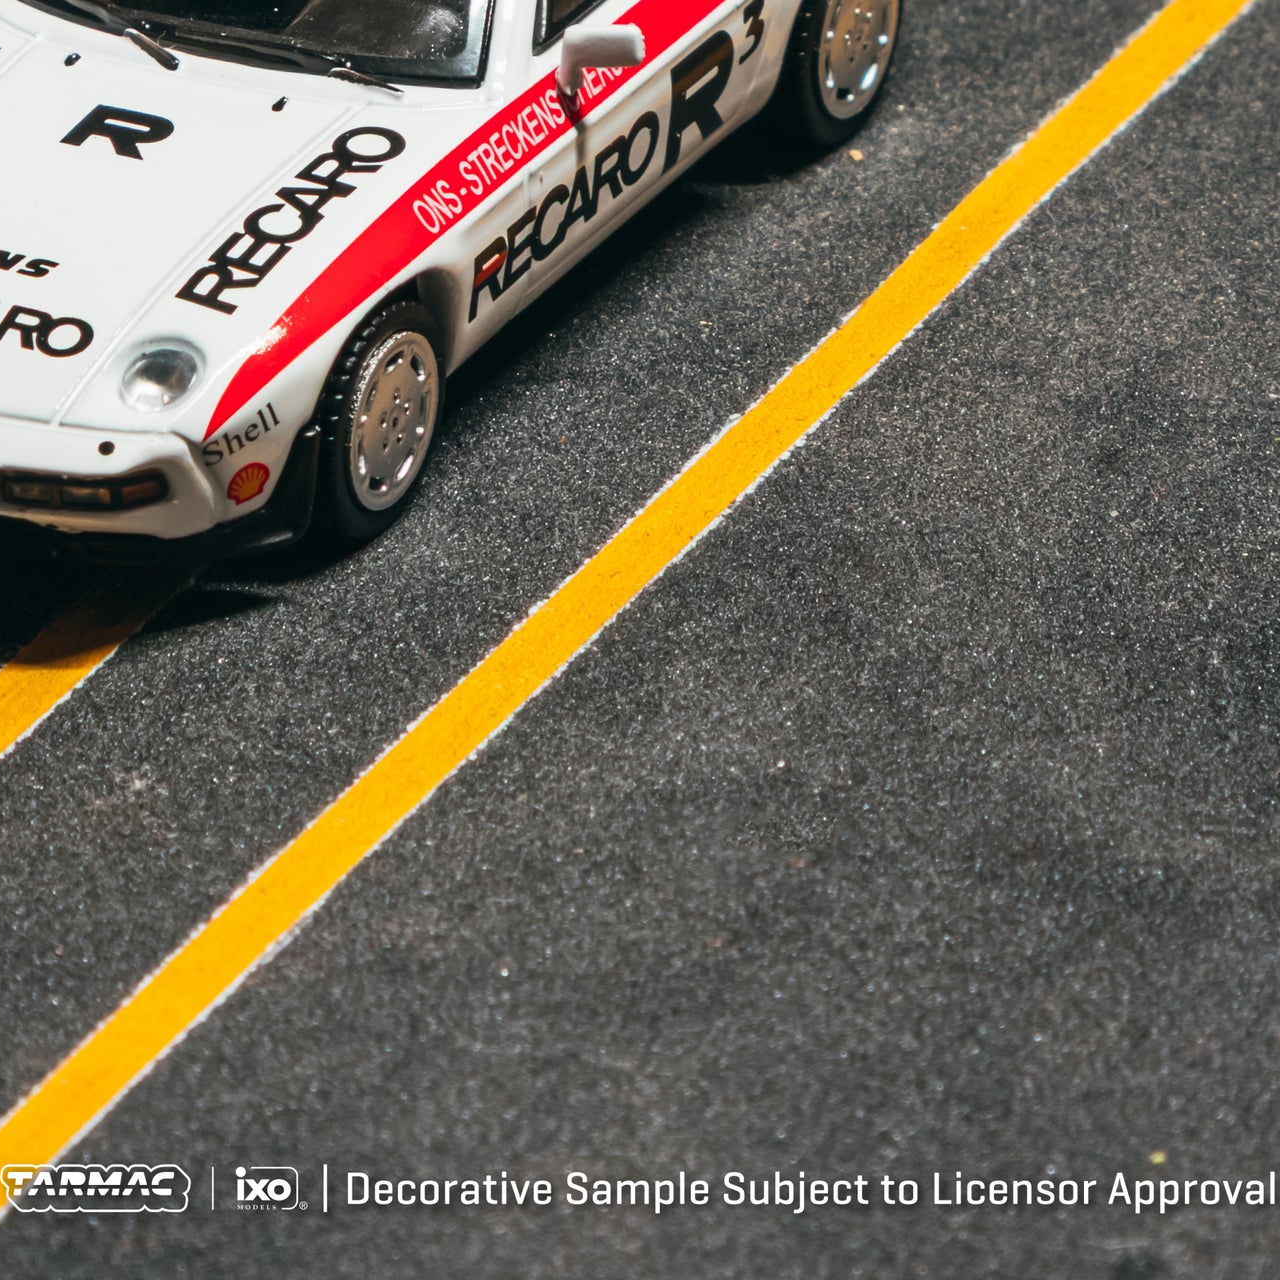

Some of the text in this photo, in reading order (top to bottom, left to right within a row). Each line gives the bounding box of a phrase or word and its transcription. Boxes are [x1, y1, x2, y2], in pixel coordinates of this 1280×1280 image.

[60, 104, 175, 161] R
[175, 126, 407, 316] RECARO
[468, 111, 660, 324] RECARO
[201, 402, 280, 467] Shell
